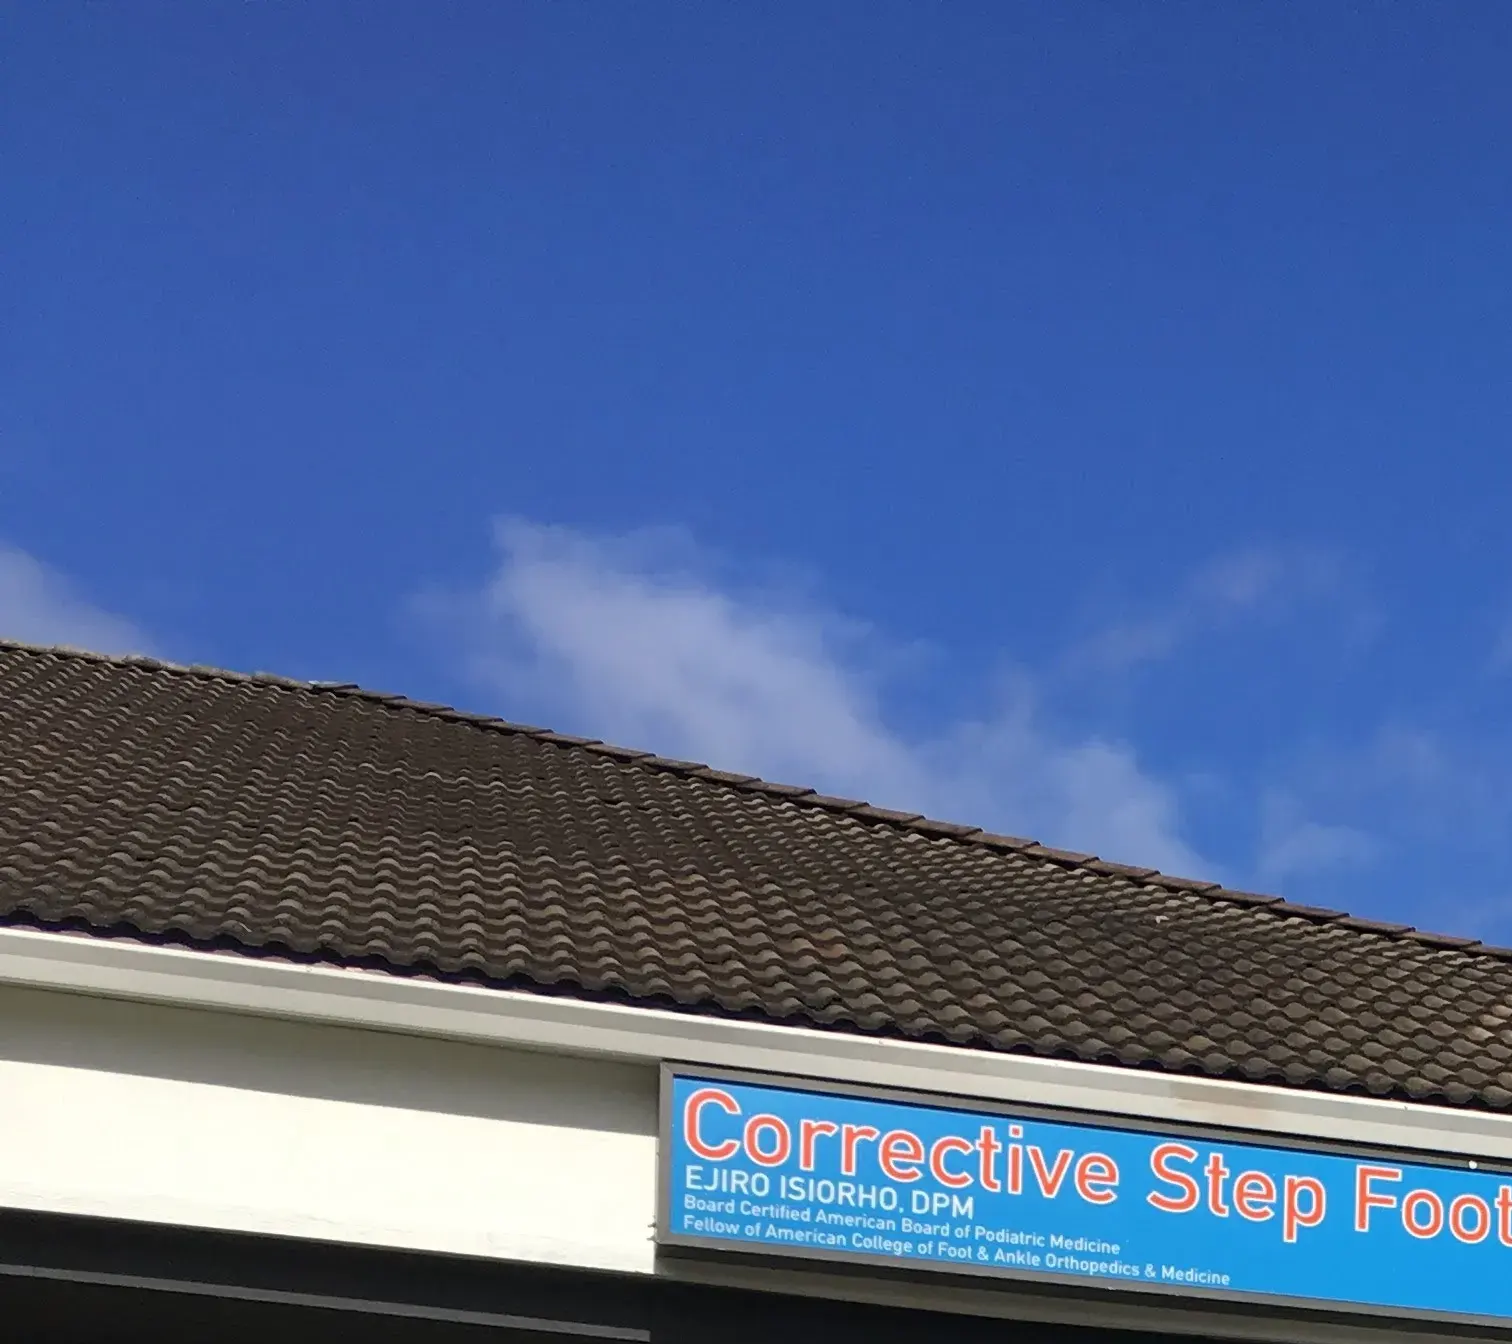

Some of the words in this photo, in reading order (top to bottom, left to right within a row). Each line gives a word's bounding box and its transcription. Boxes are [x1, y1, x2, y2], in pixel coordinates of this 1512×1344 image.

[684, 1088, 1119, 1204] Corrective
[1147, 1144, 1325, 1242] Step
[685, 1165, 770, 1197] EJIRO
[911, 1189, 975, 1219] DPM
[684, 1195, 736, 1214] Board
[740, 1201, 813, 1223] Certified
[815, 1208, 896, 1231] American
[901, 1217, 950, 1237] Board
[955, 1224, 972, 1240] of
[974, 1226, 1045, 1248] Podiatric
[1050, 1234, 1121, 1255] Medicine
[684, 1216, 740, 1235] Fellow
[745, 1222, 763, 1238] of
[765, 1225, 847, 1246] American
[852, 1233, 913, 1256] College
[917, 1240, 934, 1256] of
[938, 1242, 972, 1260] Foot
[976, 1245, 989, 1262] &
[993, 1248, 1041, 1267] Ankle
[1045, 1252, 1140, 1276] Orthopedics
[1144, 1262, 1157, 1278] &
[1160, 1266, 1230, 1286] Medicine
